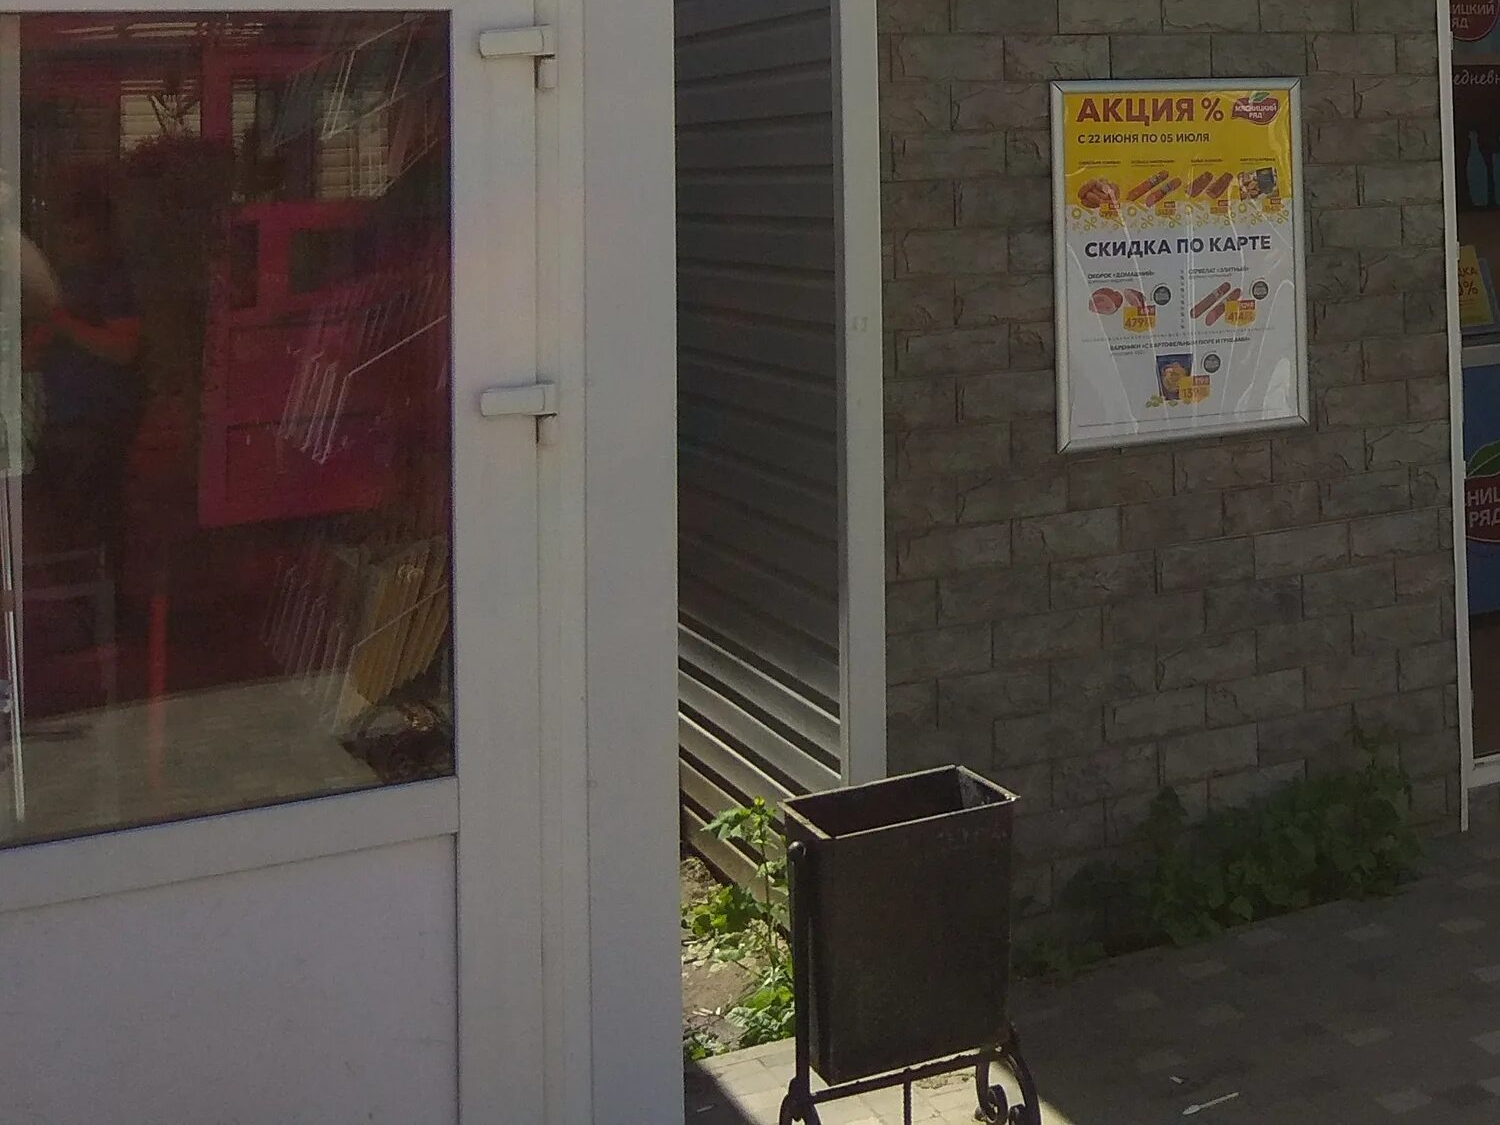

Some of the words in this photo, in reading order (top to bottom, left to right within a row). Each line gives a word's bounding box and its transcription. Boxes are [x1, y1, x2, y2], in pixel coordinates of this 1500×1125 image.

[1076, 97, 1194, 126] АКЦИЯ
[1078, 134, 1085, 144] С
[1088, 134, 1101, 144] 22
[1103, 134, 1139, 144] ИЮНЯ
[1141, 133, 1158, 143] ПО
[1160, 133, 1174, 143] 05
[1176, 133, 1210, 143] ИЮЛЯ
[1085, 239, 1172, 259] СКИДКА
[1177, 237, 1204, 253] ПО
[1209, 235, 1272, 252] КАРТЕ
